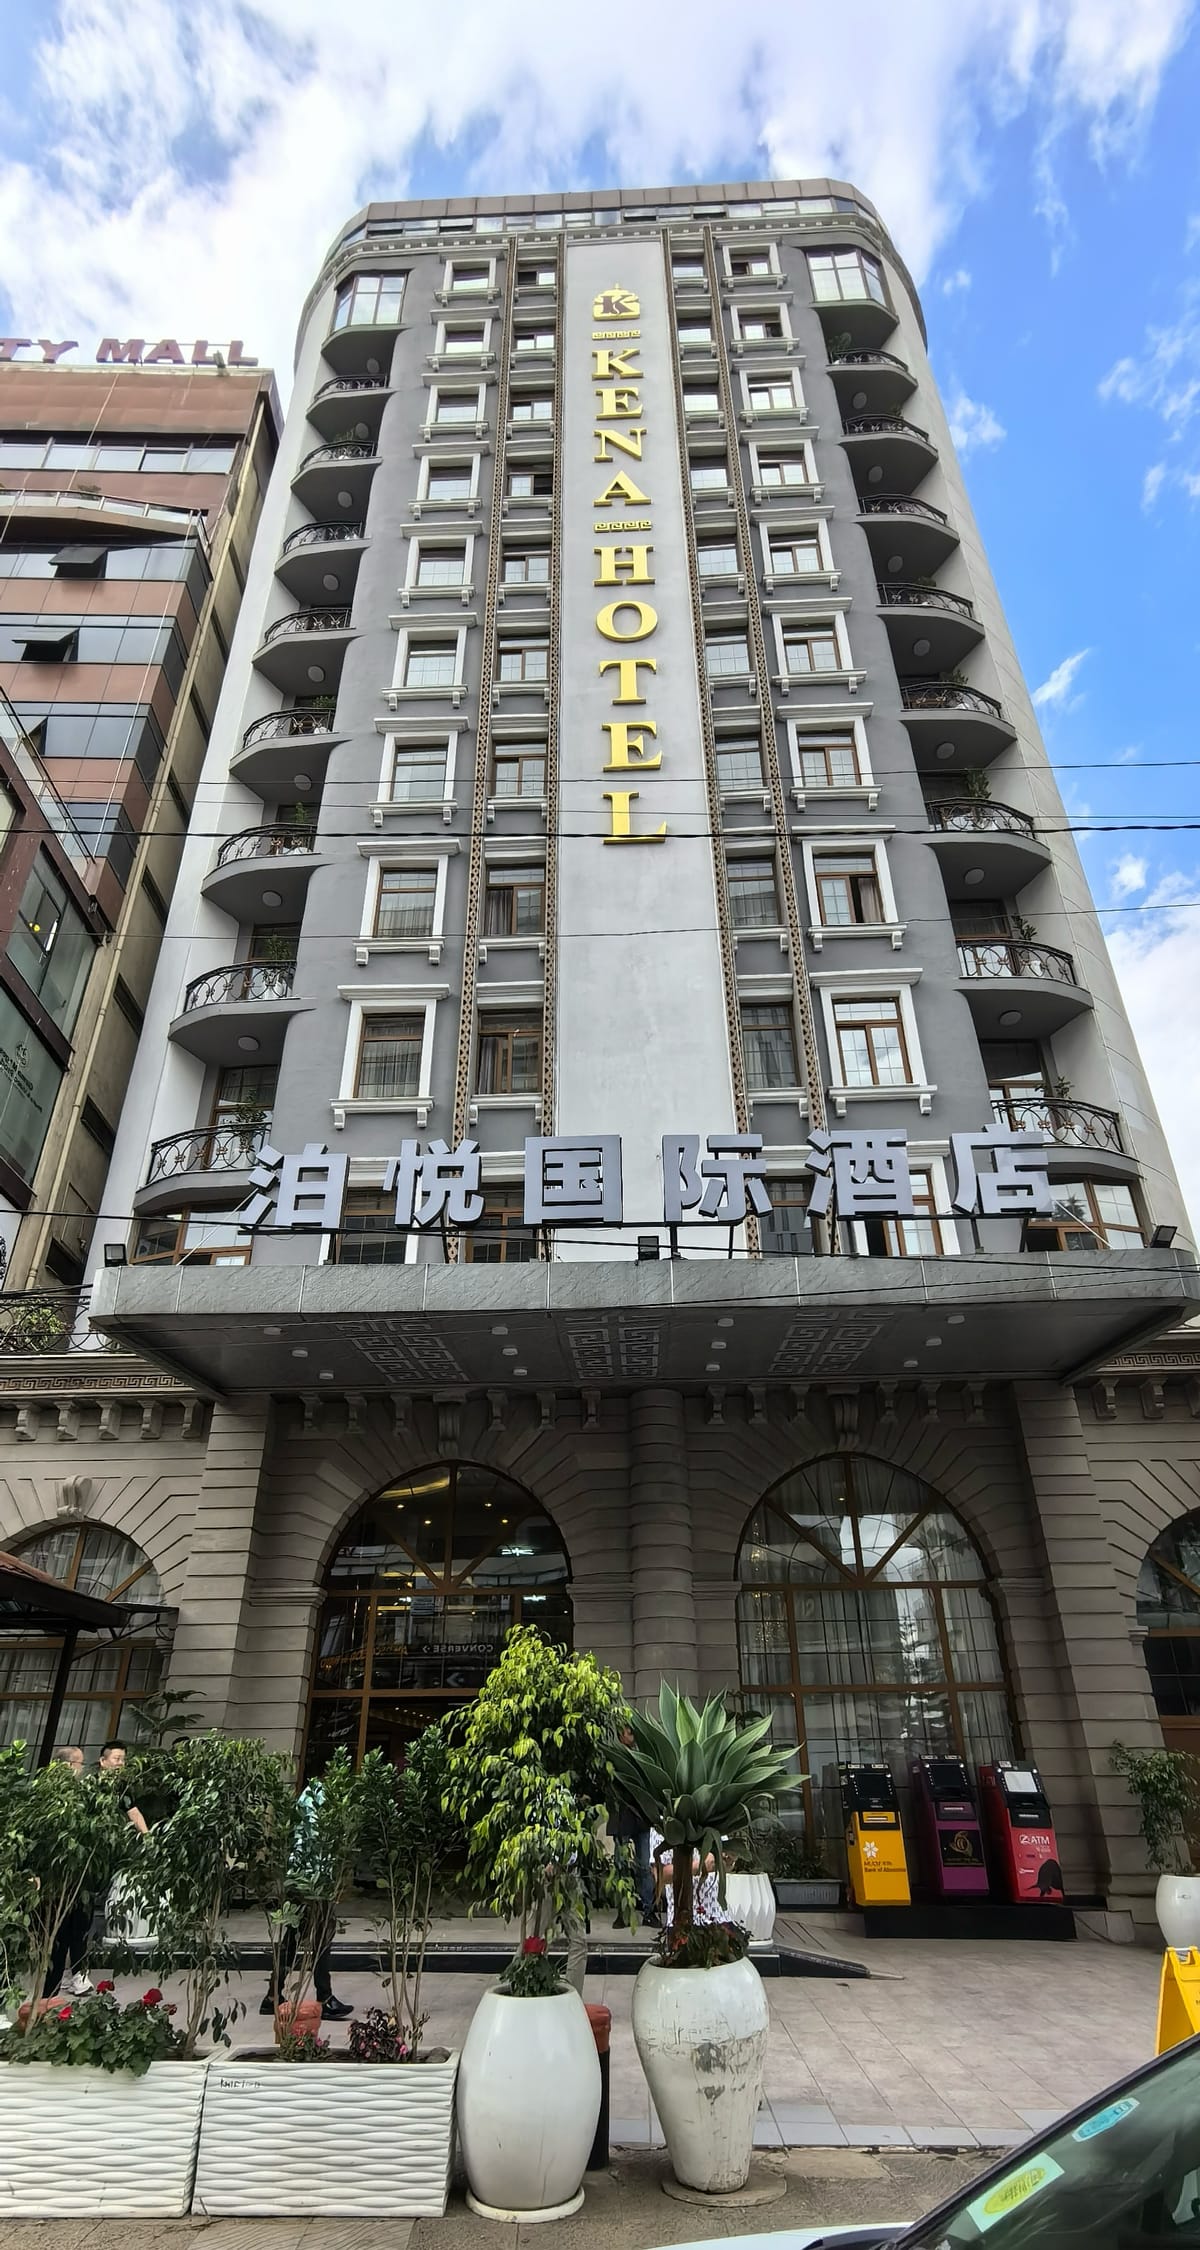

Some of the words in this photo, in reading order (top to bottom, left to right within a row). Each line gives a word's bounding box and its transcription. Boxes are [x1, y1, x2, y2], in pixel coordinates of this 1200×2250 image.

[96, 339, 258, 366] MALL
[591, 348, 652, 507] KENA
[594, 544, 668, 844] HOTEL
[239, 1123, 1055, 1228] 泊悦国际酒店
[1031, 1835, 1050, 1844] ATM
